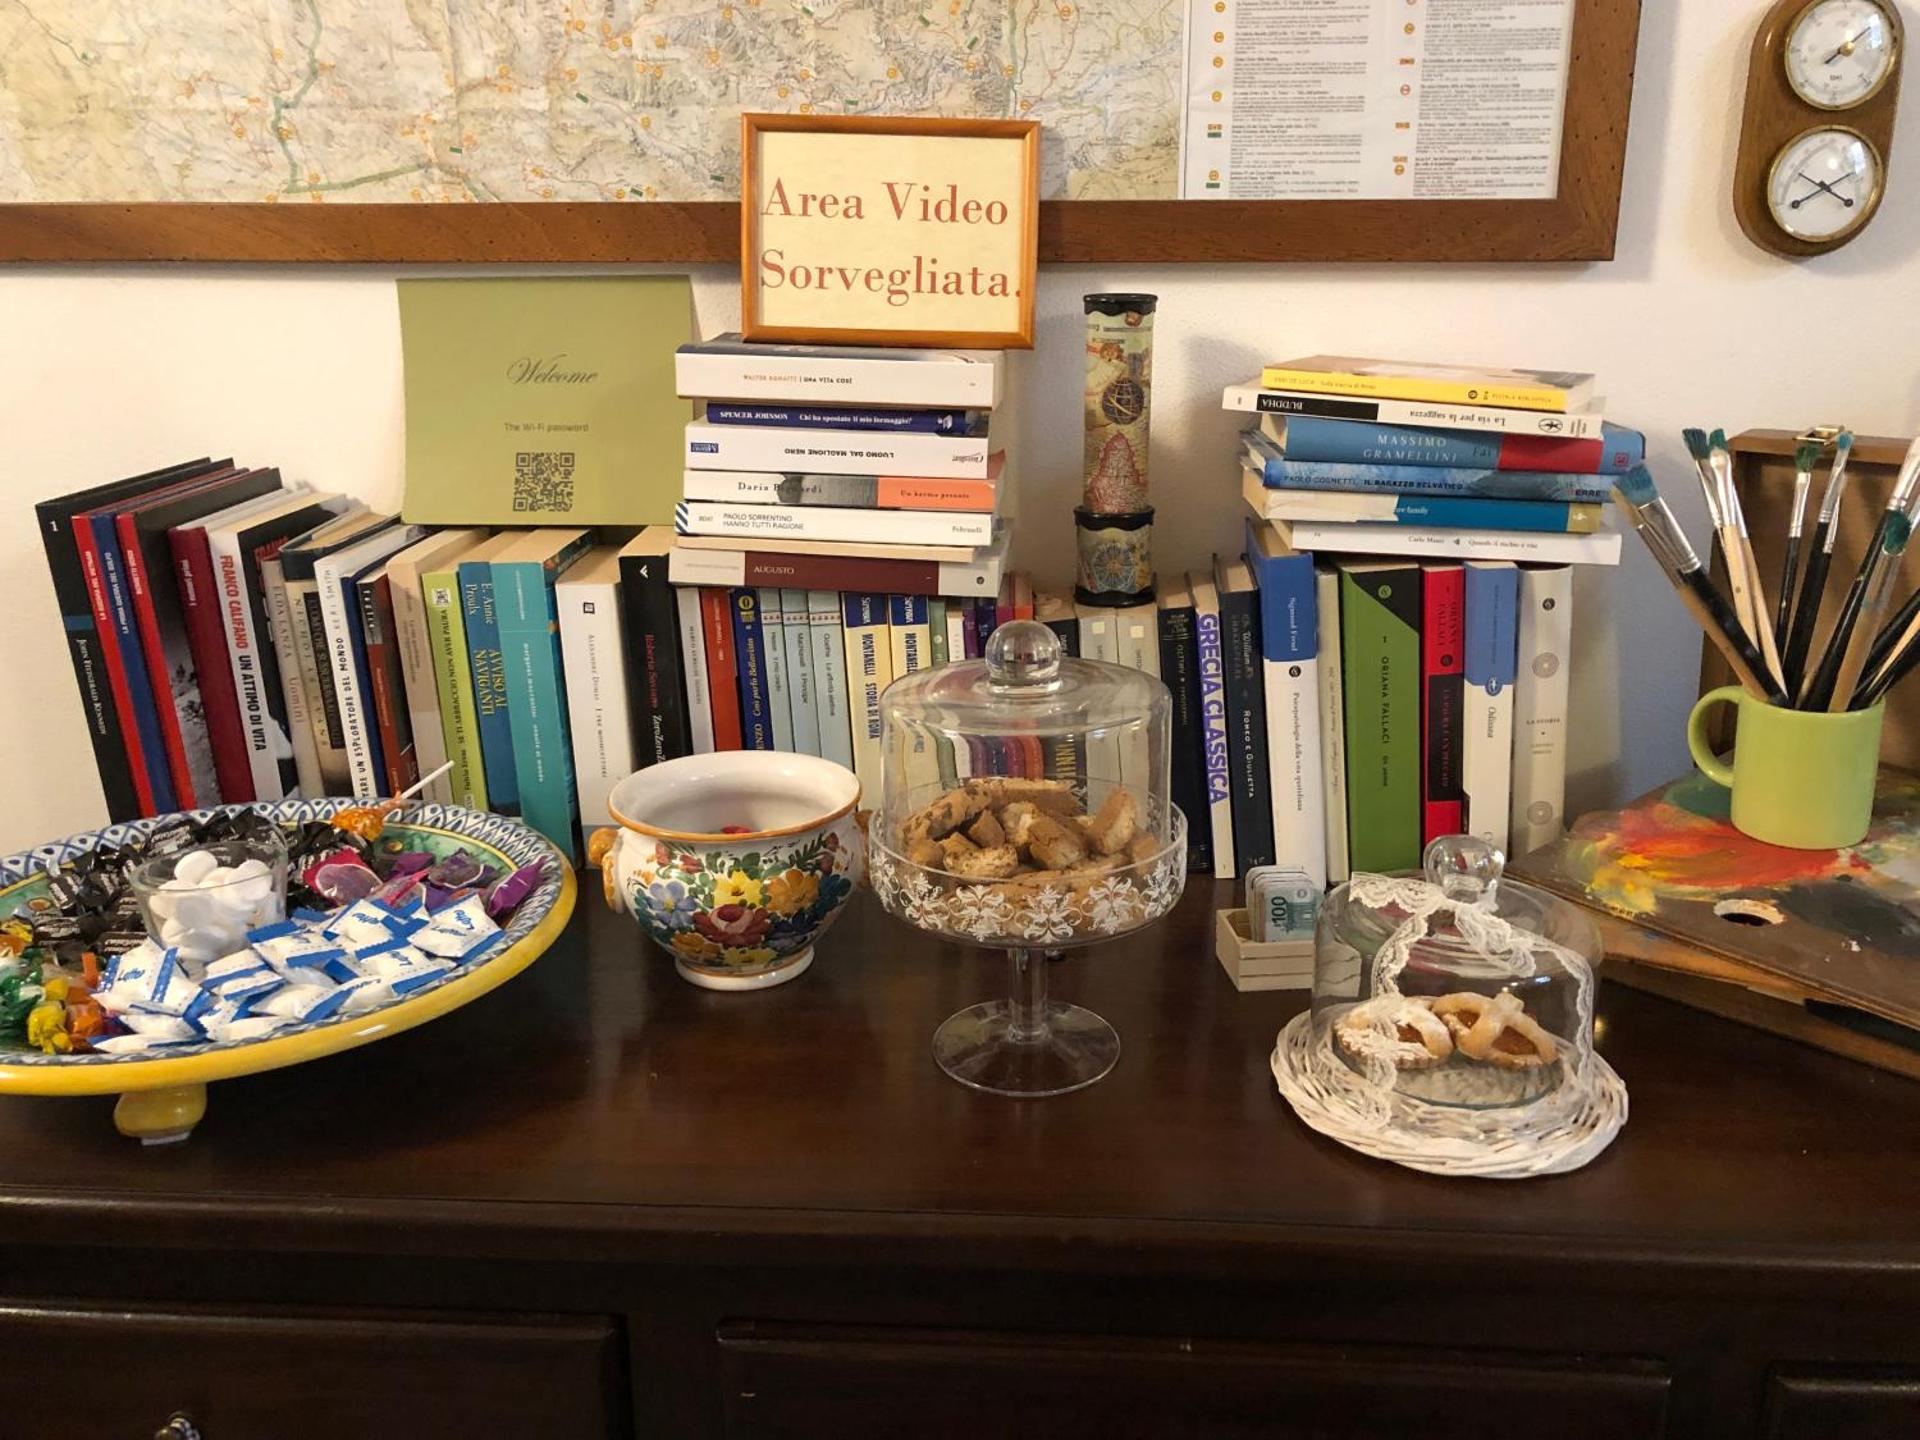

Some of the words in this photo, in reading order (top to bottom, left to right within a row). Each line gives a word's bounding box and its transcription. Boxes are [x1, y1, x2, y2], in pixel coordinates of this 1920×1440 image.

[761, 177, 864, 219] Area
[882, 182, 1008, 224] Video
[761, 249, 1021, 306] Sorvegliata.
[506, 354, 598, 384] Welcome
[720, 412, 753, 420] SPENCER
[754, 412, 788, 420] JOHNSON
[1262, 399, 1303, 410] BUDDHA
[1410, 410, 1446, 420] saggezza
[504, 422, 520, 432] The
[523, 422, 544, 432] Wi-Fi
[546, 423, 588, 433] password
[1449, 413, 1456, 422] la
[1459, 414, 1475, 423] per
[1377, 434, 1447, 448] MASSIMO
[1363, 449, 1457, 462] GRAMELLINI
[738, 482, 769, 491] Daria
[1416, 481, 1463, 490] SELVATICO
[50, 520, 58, 531] 1
[723, 513, 747, 521] PAOLO
[748, 514, 792, 522] SORRENTINO
[1408, 535, 1425, 543] Carlo
[109, 572, 118, 583] DEL
[220, 555, 238, 597] FRANCO
[754, 565, 794, 574] AUGUSTO
[324, 570, 336, 600] SMITH
[481, 582, 492, 592] E.
[465, 583, 477, 615] Proulx
[482, 595, 494, 624] Annie
[439, 609, 450, 634] PAURA
[1286, 596, 1297, 628] Sigmund
[121, 626, 129, 634] LA
[228, 599, 248, 649] CALIFANO
[1437, 603, 1445, 646] FALLACI
[443, 635, 453, 656] AVER
[643, 633, 658, 670] Roberto
[904, 632, 918, 672] MONTANELL
[1241, 631, 1252, 664] William
[1288, 630, 1298, 651] Freud
[238, 655, 251, 670] UN
[336, 637, 348, 672] MONDO
[861, 633, 875, 675] MONTANELLI
[1199, 614, 1223, 696] GRECIA
[446, 658, 456, 678] NON
[490, 650, 506, 692] AVVISO
[1381, 656, 1390, 698] ORIANA
[242, 672, 260, 711] ATTIMO
[344, 675, 352, 692] DEL
[475, 650, 494, 715] NAVIGANTI
[799, 677, 810, 704] Principe
[286, 676, 306, 724] Uomini
[448, 677, 463, 724] ABBRACCIO
[494, 694, 507, 707] AI
[864, 682, 877, 707] STORIA
[250, 713, 261, 725] DI
[866, 709, 878, 717] DI
[1289, 692, 1302, 741] Psicopatologia
[1381, 701, 1390, 744] FALLACI
[347, 696, 363, 758] ESPLORATORE
[867, 718, 880, 739] ROMA
[1242, 709, 1252, 742] ROMEO
[252, 728, 267, 750] VITA
[457, 734, 465, 744] SE
[1293, 742, 1301, 758] della
[459, 748, 468, 767] Ervas
[1204, 701, 1229, 804] CLASSICA
[358, 758, 367, 774] UN
[1244, 752, 1255, 798] GIULIETTA
[462, 768, 472, 790] Fulvio
[1294, 775, 1304, 811] quotidiana
